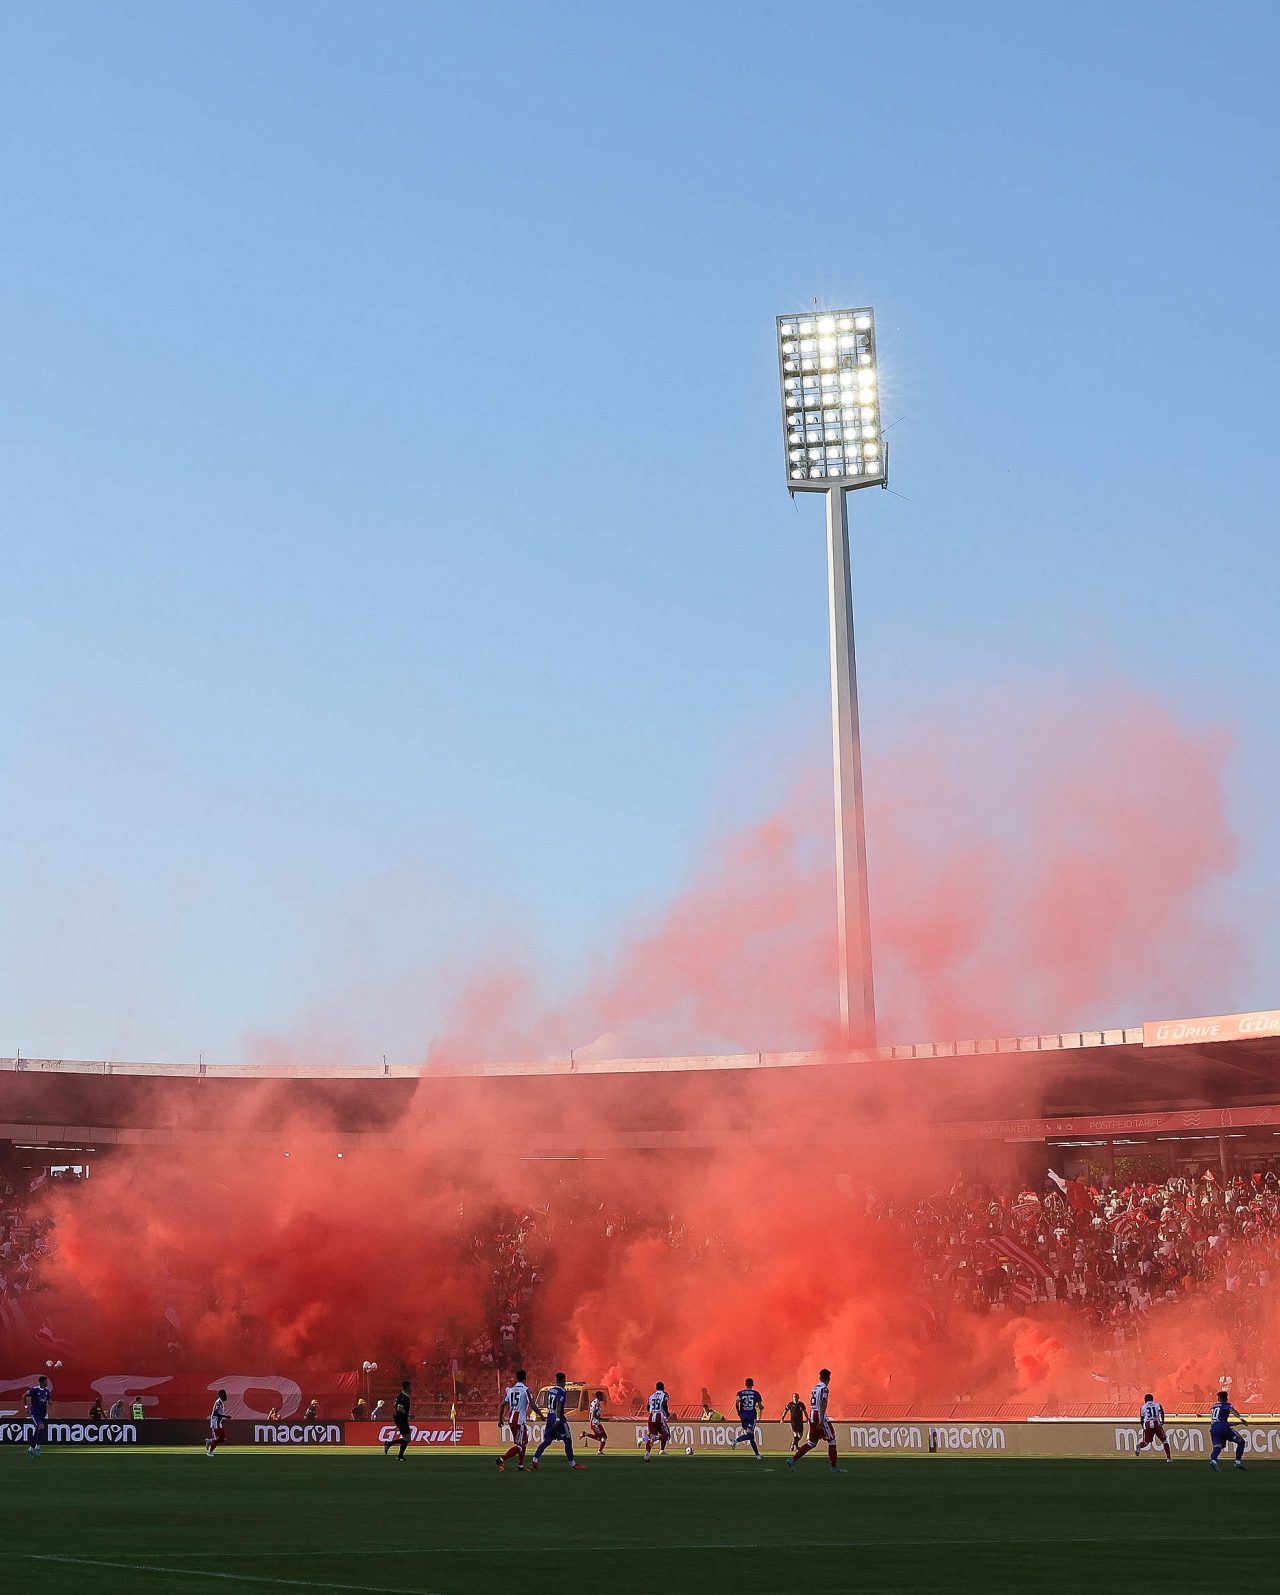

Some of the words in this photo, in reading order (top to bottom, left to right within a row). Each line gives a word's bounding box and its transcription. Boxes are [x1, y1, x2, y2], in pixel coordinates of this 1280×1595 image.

[999, 1124, 1030, 1134] PAKETI
[1133, 1118, 1162, 1128] TARIFE
[47, 1423, 137, 1442] macron
[254, 1424, 341, 1443] macron
[849, 1426, 922, 1448] macron
[928, 1427, 1006, 1449] macron
